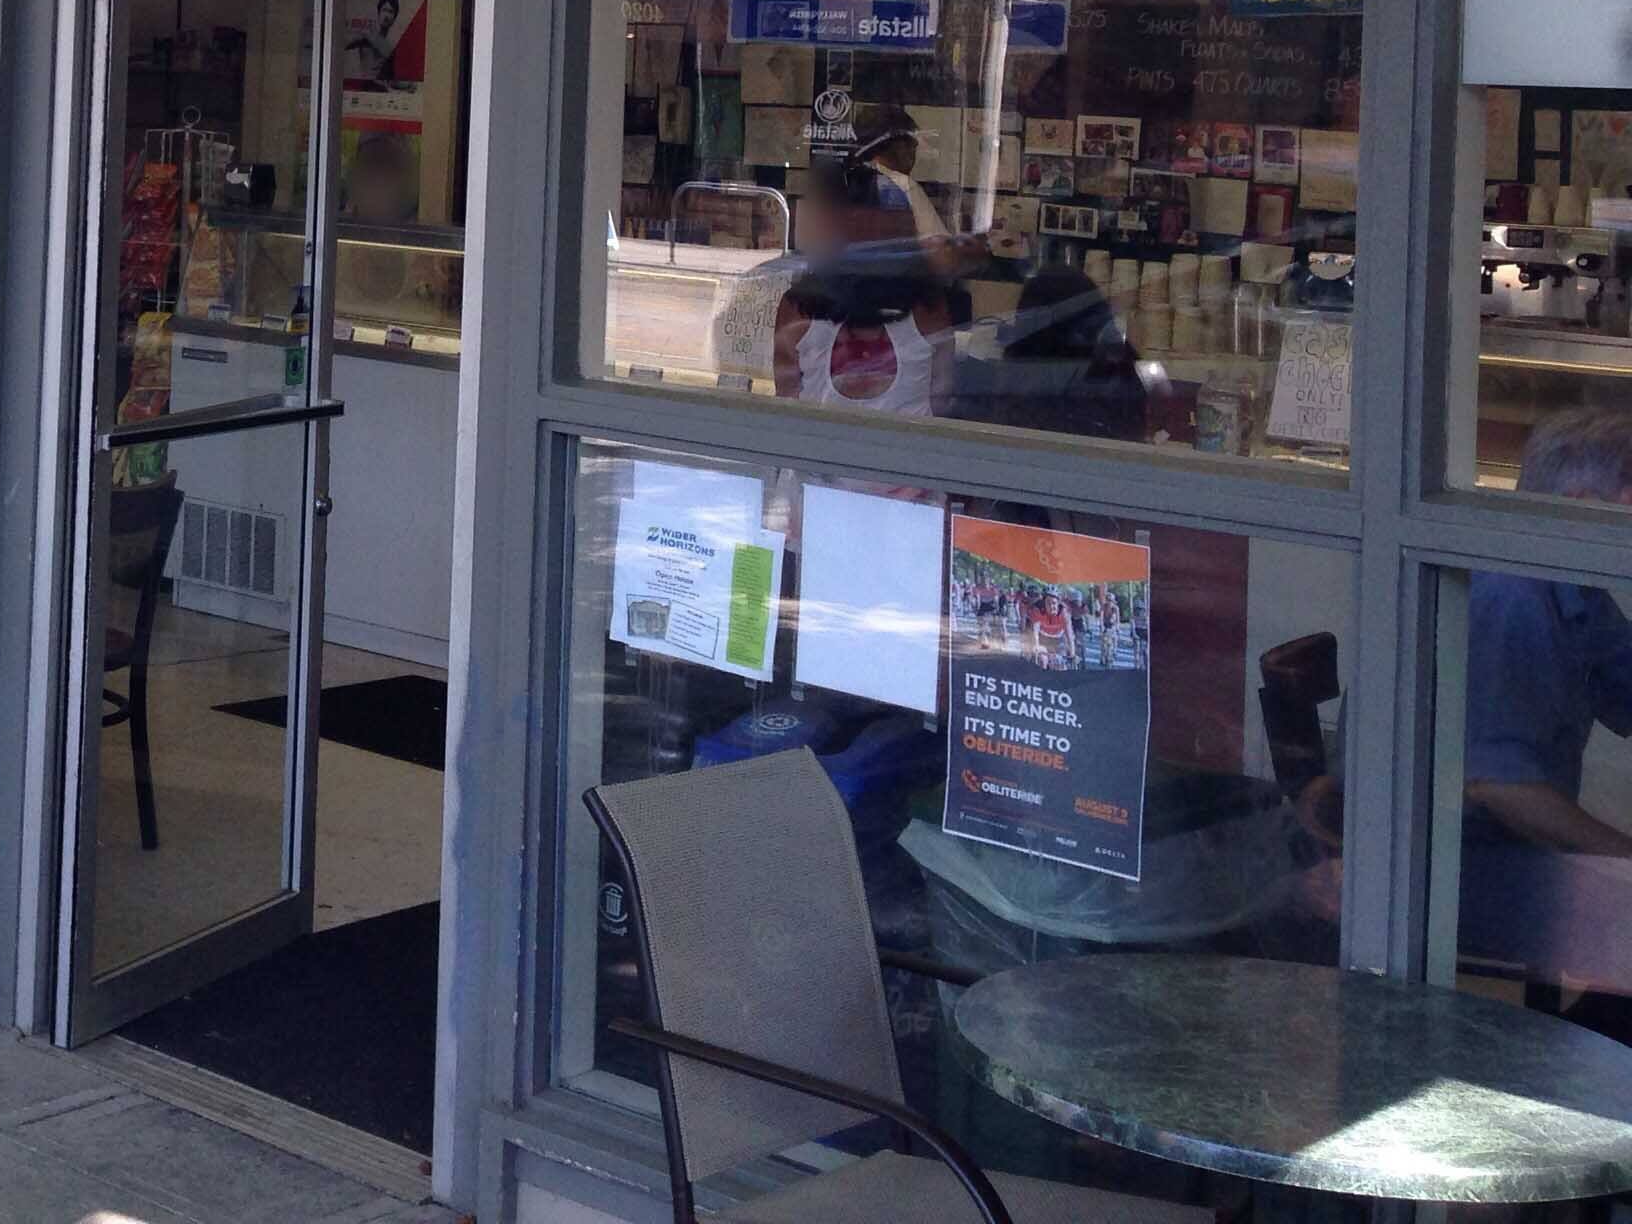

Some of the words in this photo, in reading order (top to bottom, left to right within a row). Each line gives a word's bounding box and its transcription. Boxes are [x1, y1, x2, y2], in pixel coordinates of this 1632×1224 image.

[1296, 389, 1345, 412] ONLY!
[660, 537, 716, 558] HORIZONS
[965, 672, 997, 692] IT'S
[1001, 679, 1043, 702] TIME
[1047, 689, 1072, 707] TO
[965, 690, 1002, 710] END
[1006, 700, 1083, 728] CANCER.
[964, 716, 995, 736] IT'S
[999, 724, 1041, 746] TIME
[1045, 733, 1071, 752] TO
[963, 734, 1069, 771] OBLITERIDE.
[981, 781, 1043, 806] OBLITERIDE
